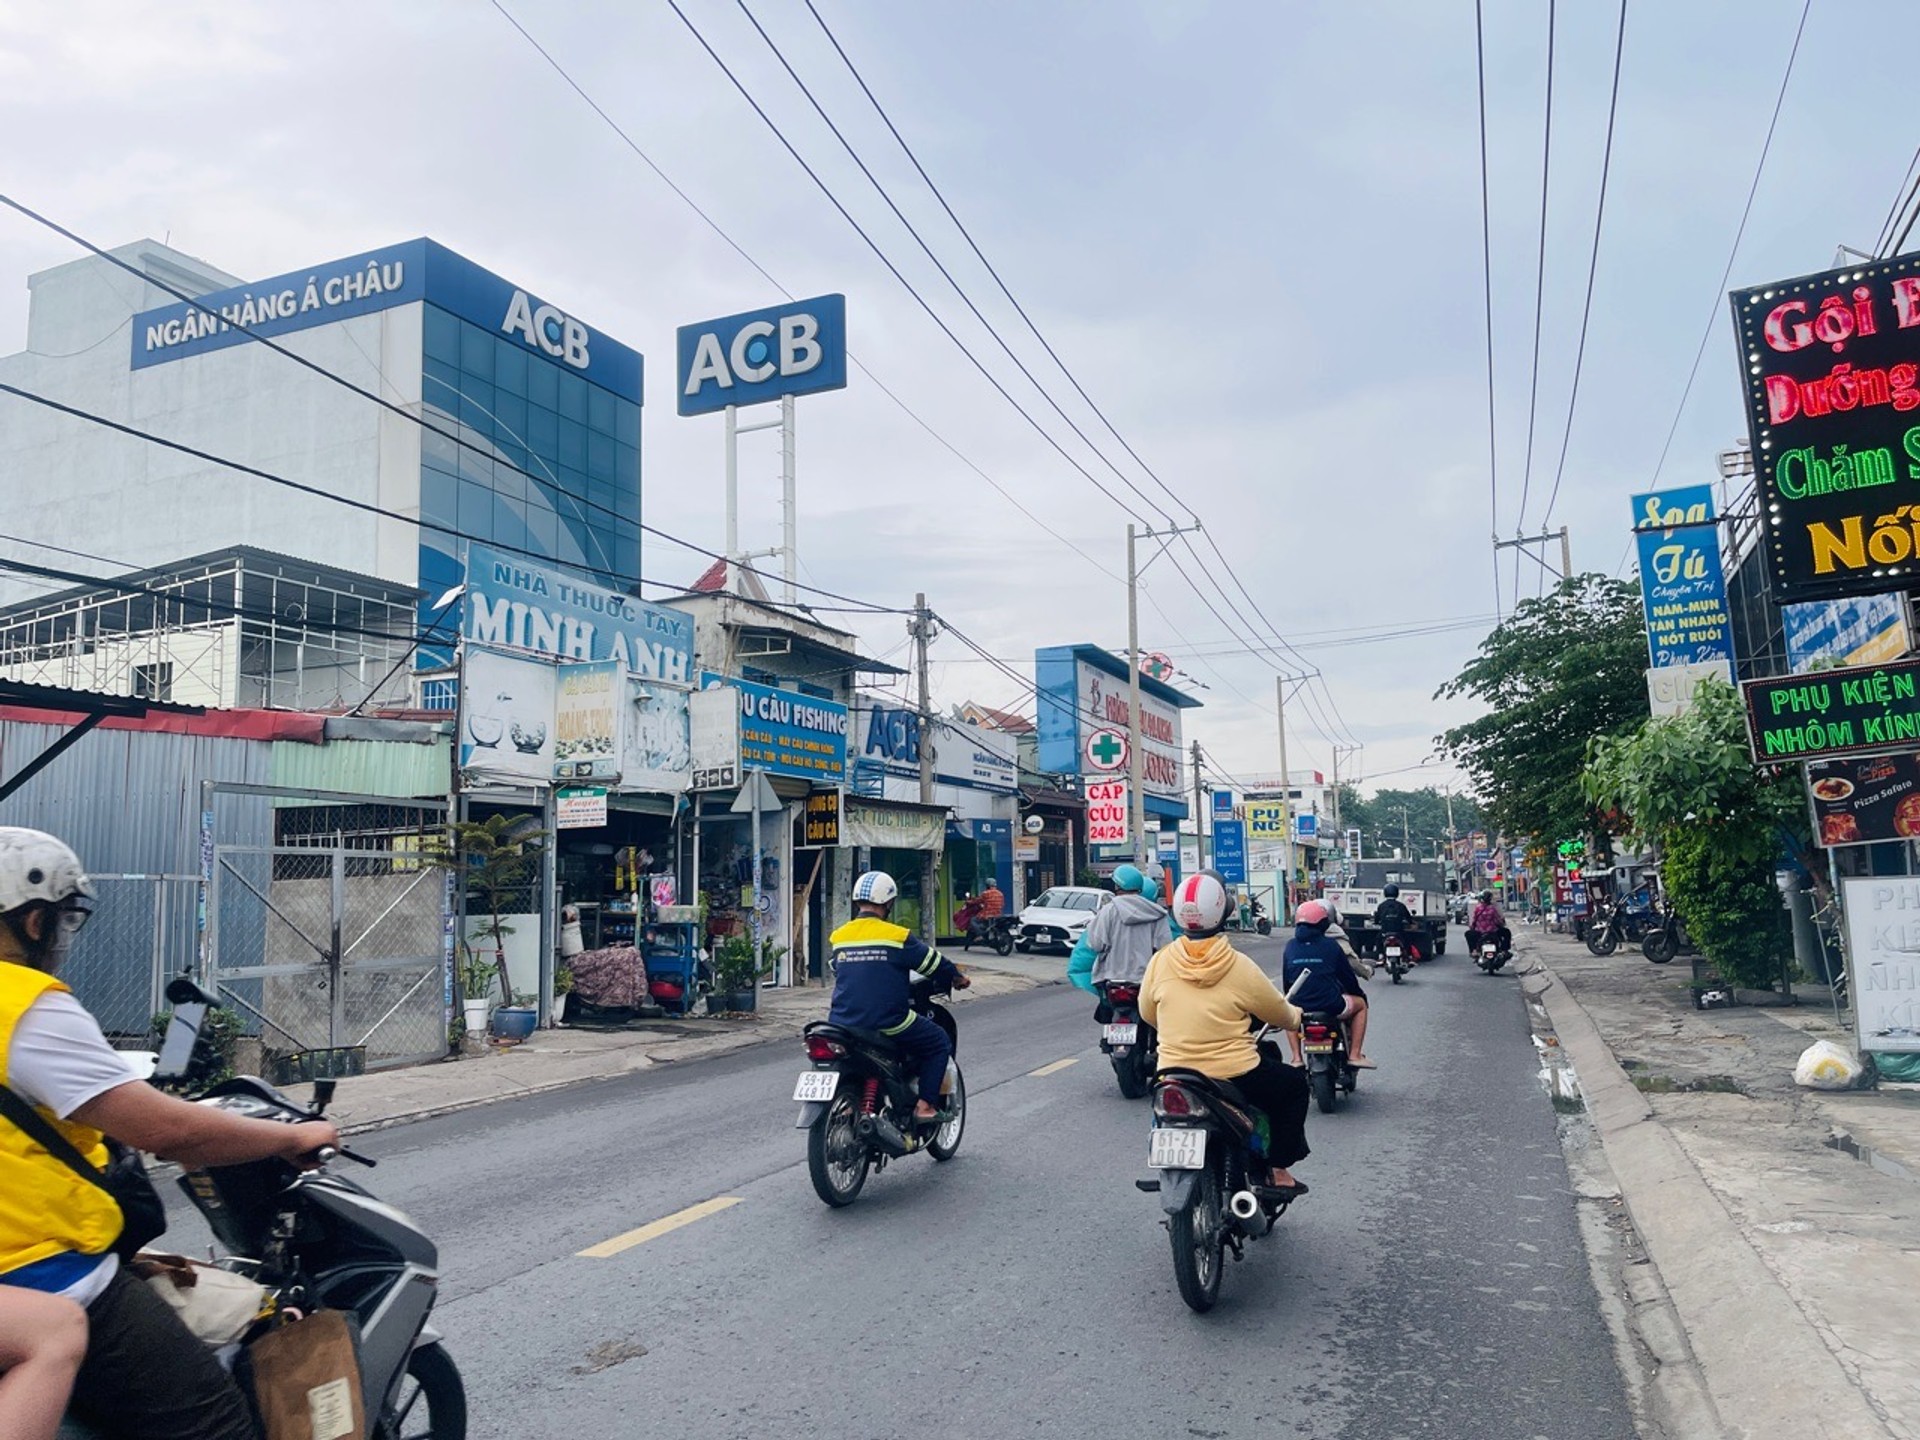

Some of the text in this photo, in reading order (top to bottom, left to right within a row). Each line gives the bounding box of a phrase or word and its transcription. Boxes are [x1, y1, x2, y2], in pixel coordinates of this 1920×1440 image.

[146, 260, 404, 350] NGÂN HÀNG Á CHÂU
[1764, 286, 1877, 353] Gội
[502, 290, 590, 370] ACB
[684, 313, 824, 396] ACB
[1764, 361, 1920, 426] Dưỡng
[1776, 444, 1897, 500] Chăm
[1638, 496, 1710, 541] Spa
[493, 561, 550, 599] NHÀ
[470, 591, 689, 683] MINH ANH
[1679, 613, 1728, 630] NHANG
[1770, 670, 1916, 715] PHỤ KIỆN
[758, 692, 790, 724] CÂU
[793, 703, 848, 735] FISHING
[1763, 708, 1920, 755] NHÔM KÍN
[1089, 777, 1124, 800] CẤP
[1853, 793, 1880, 810] Pizza
[808, 818, 838, 840] CÂU CÁ
[896, 811, 921, 829] NAM
[1089, 803, 1124, 822] CỨU
[1252, 808, 1280, 820] PU
[1252, 820, 1281, 832] NC
[1089, 826, 1124, 840] 24/24
[1156, 1149, 1197, 1165] 0002
[1158, 1131, 1197, 1148] 61-Z1
